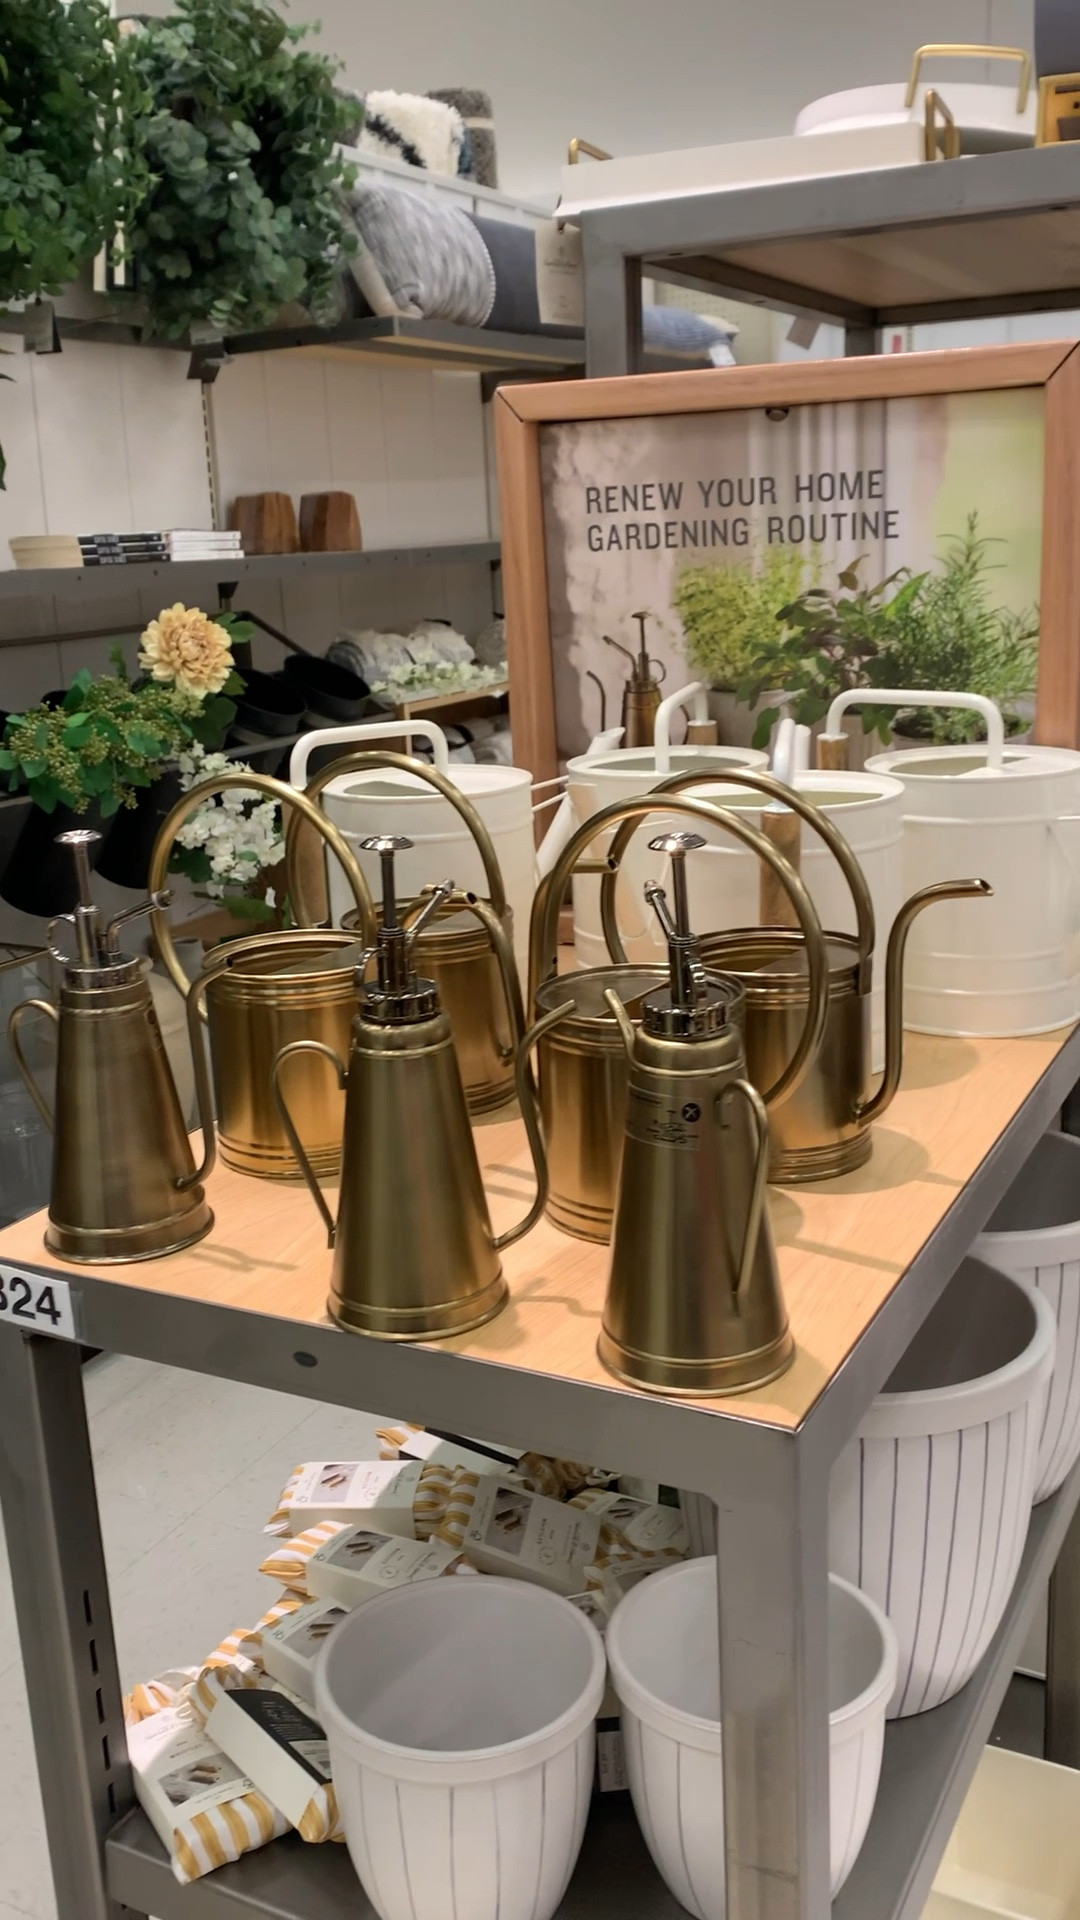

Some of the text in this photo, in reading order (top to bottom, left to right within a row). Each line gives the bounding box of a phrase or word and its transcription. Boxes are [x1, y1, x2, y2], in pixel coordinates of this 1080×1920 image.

[586, 470, 884, 514] RENEW YOUR HOME
[587, 510, 900, 552] GARDENING ROUTINE
